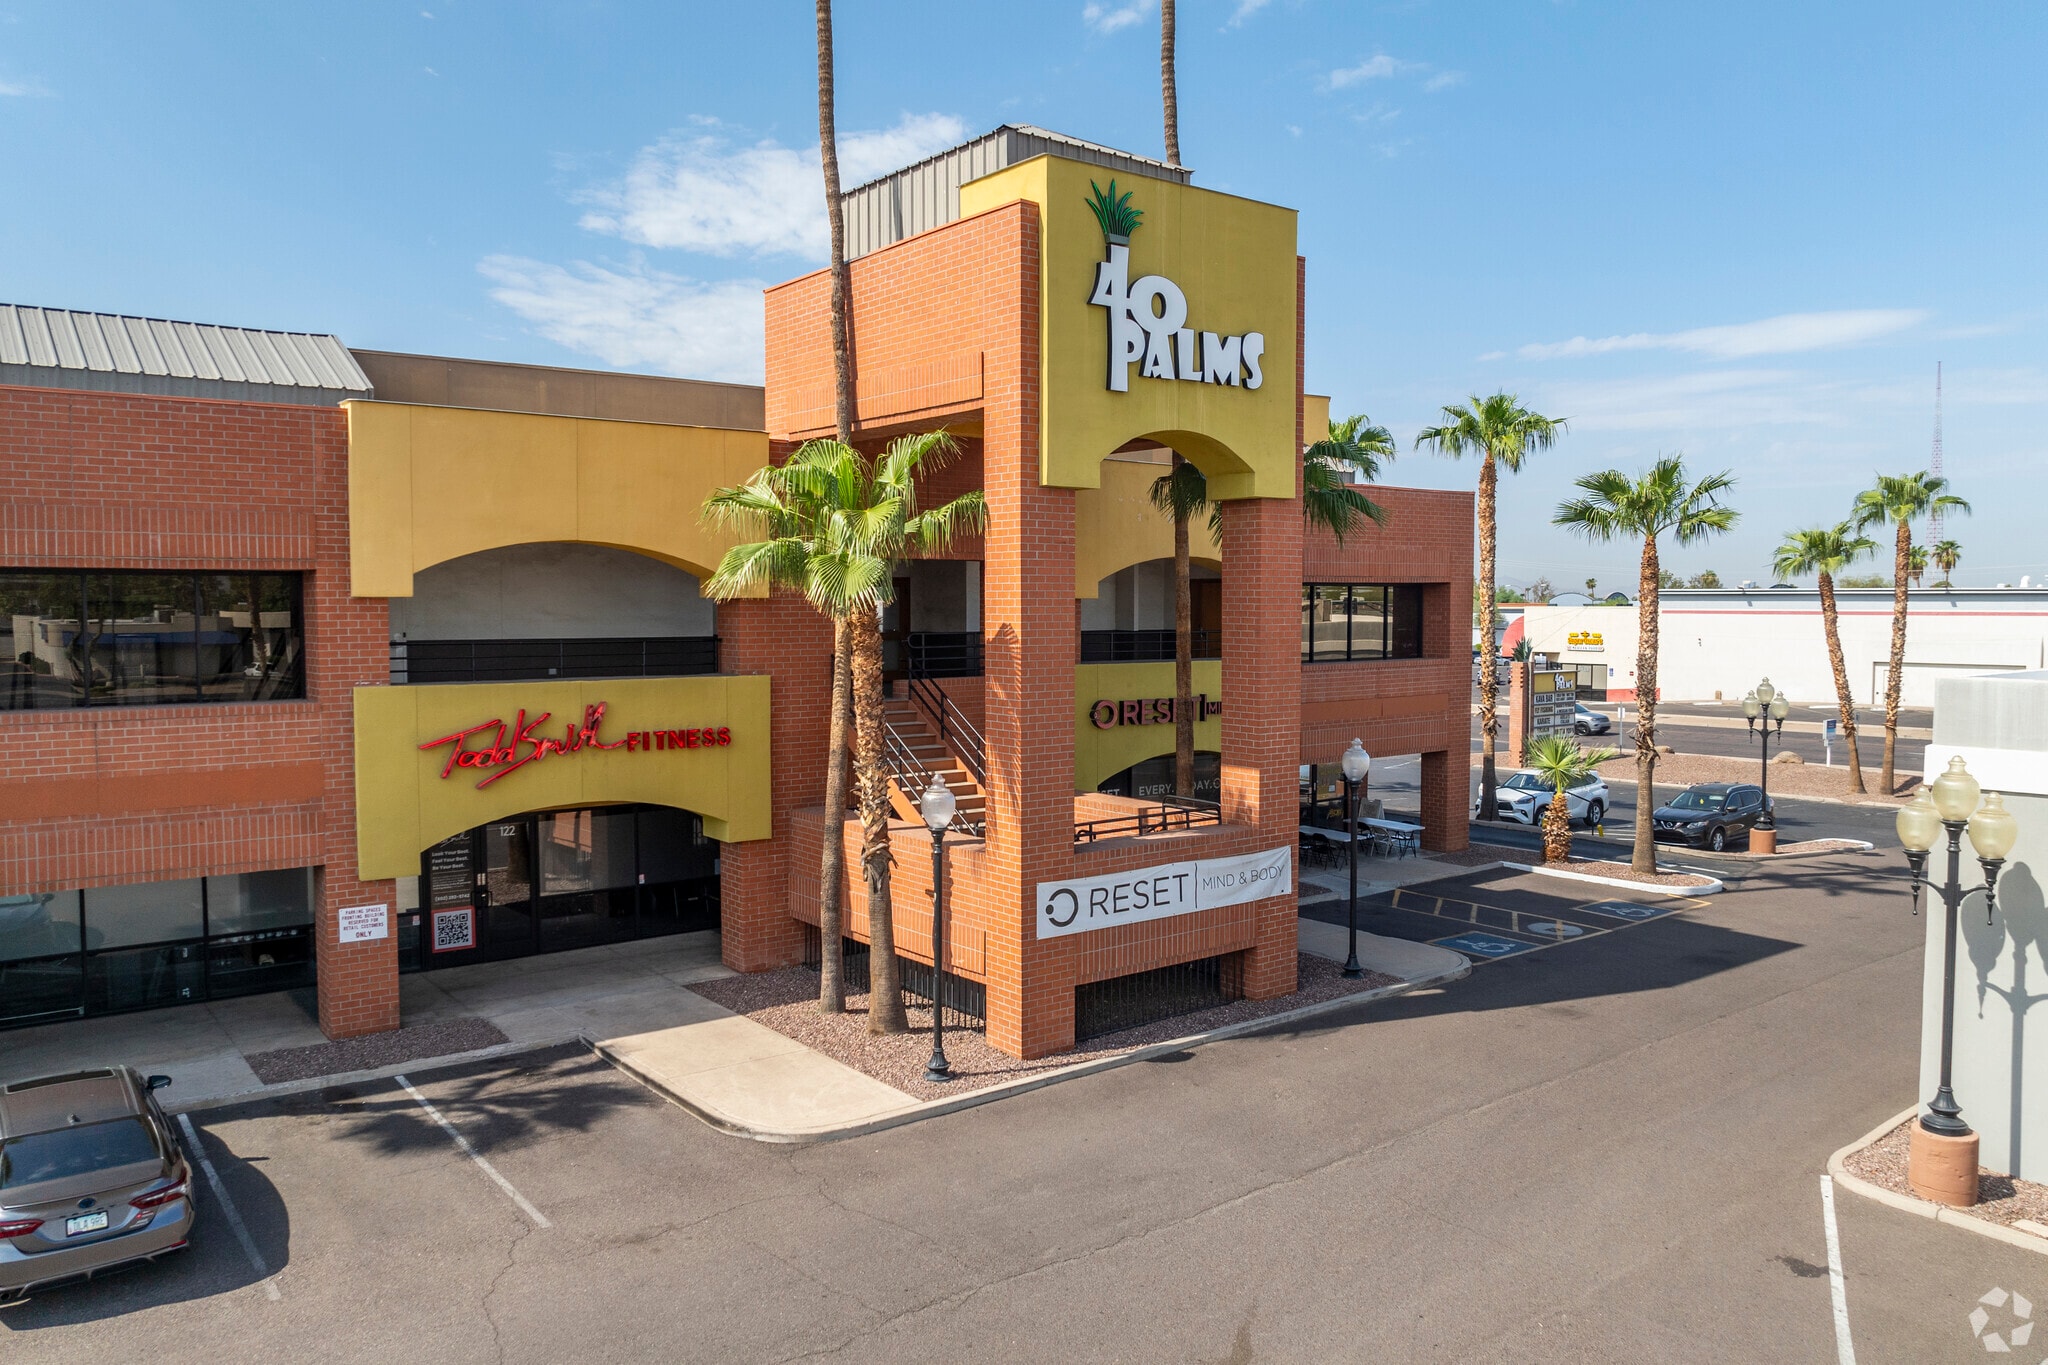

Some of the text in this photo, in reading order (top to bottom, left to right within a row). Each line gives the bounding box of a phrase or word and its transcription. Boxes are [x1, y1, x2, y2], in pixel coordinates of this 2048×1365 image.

[1087, 244, 1188, 336] 40
[1105, 318, 1265, 392] PALMS
[1545, 694, 1553, 702] BAR
[1537, 717, 1551, 725] KARATE
[626, 726, 733, 753] FITNESS
[1138, 783, 1174, 796] EVERY.
[500, 825, 516, 837] 122
[1090, 864, 1285, 918] RESET MIND & BODY
[355, 930, 372, 938] ONLY
